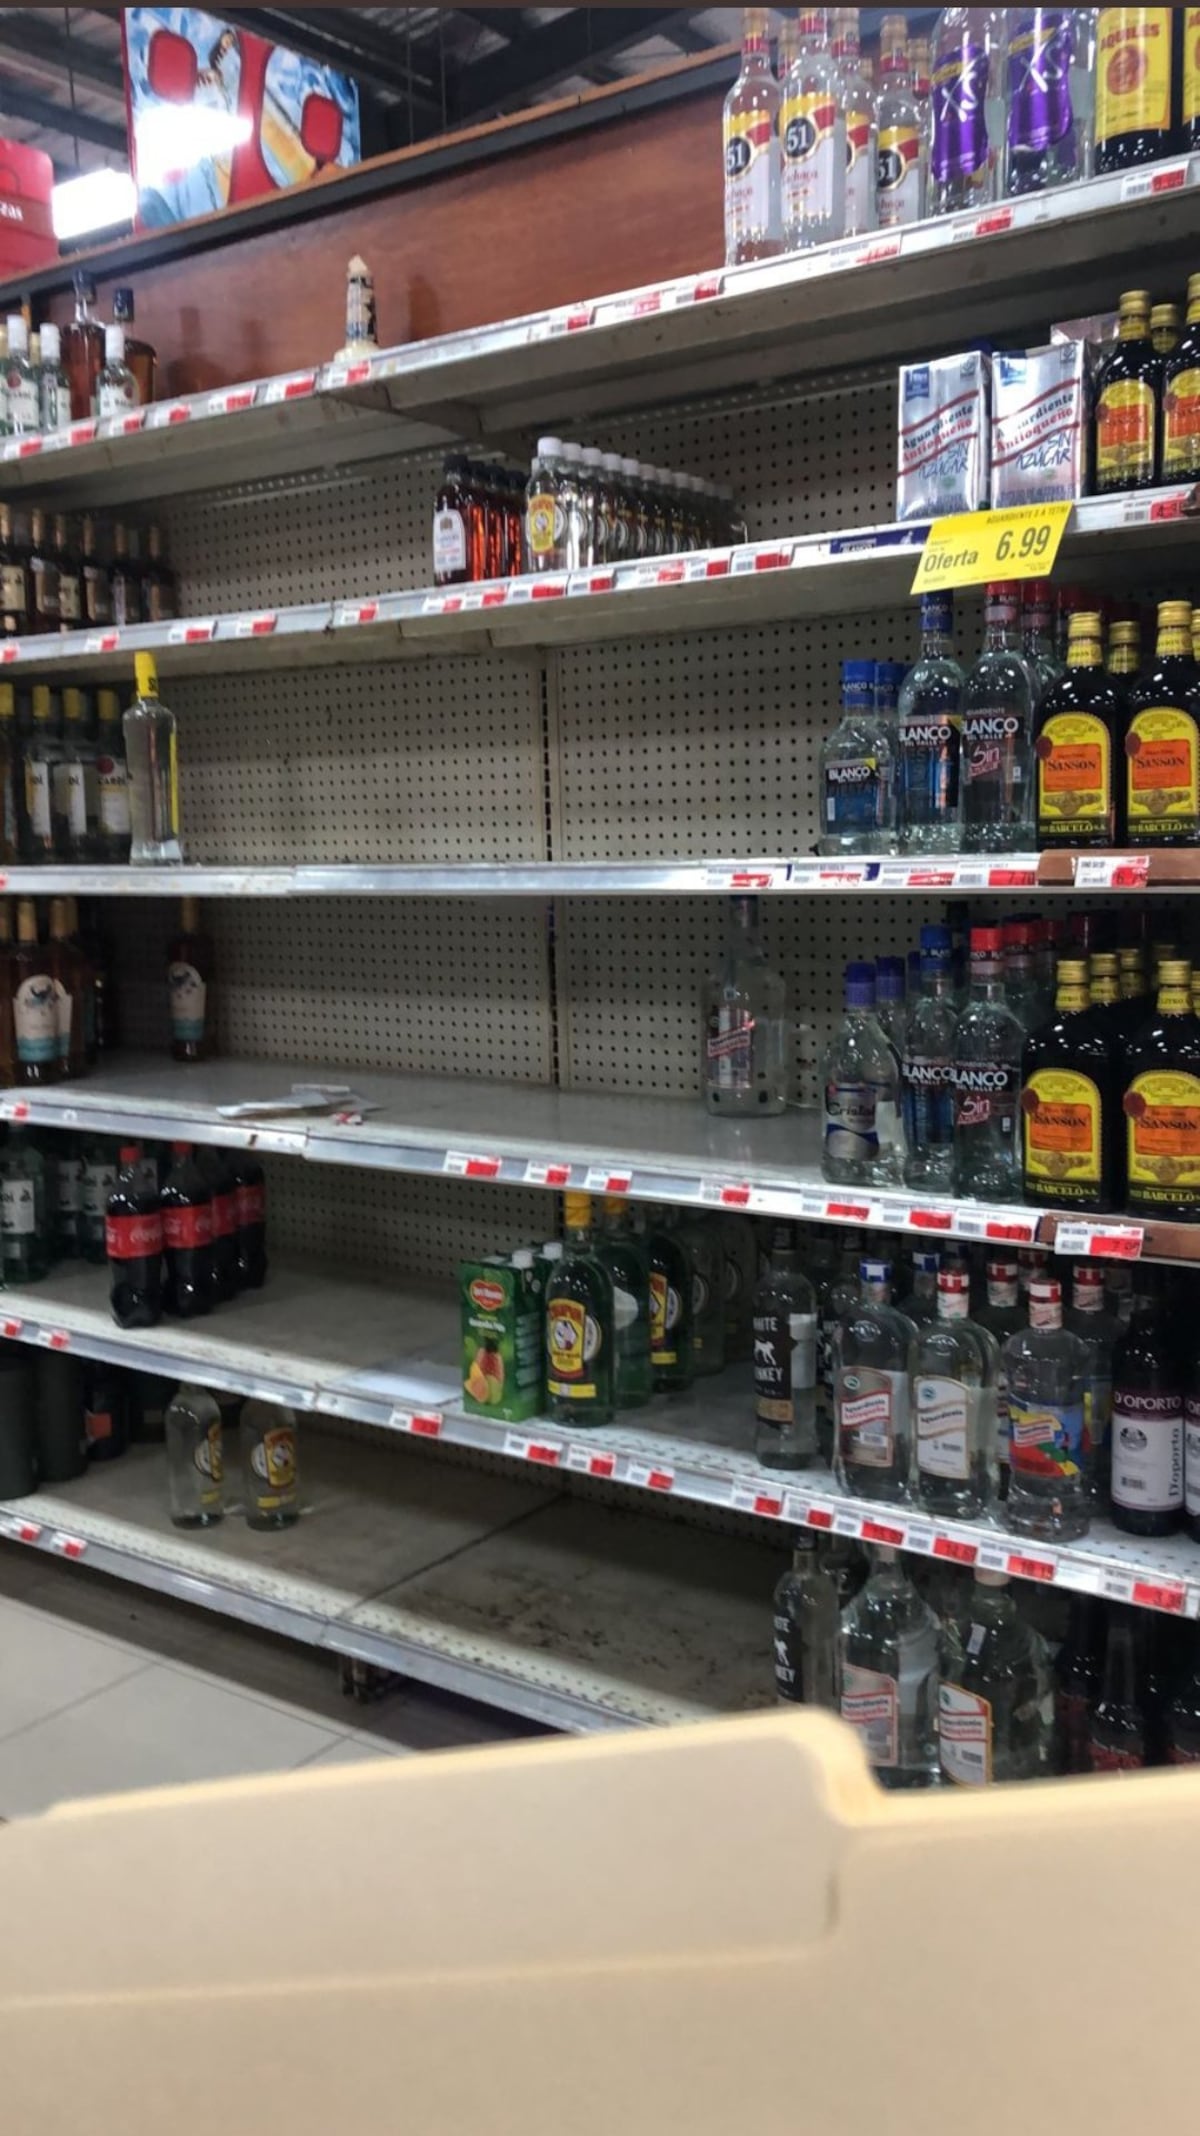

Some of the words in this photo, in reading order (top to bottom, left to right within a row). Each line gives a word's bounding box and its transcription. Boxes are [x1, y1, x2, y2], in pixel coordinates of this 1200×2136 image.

[787, 124, 808, 151] 51
[727, 142, 745, 171] 51
[996, 525, 1052, 562] 6.99
[923, 550, 979, 574] Oferta
[828, 765, 871, 781] BLANCO
